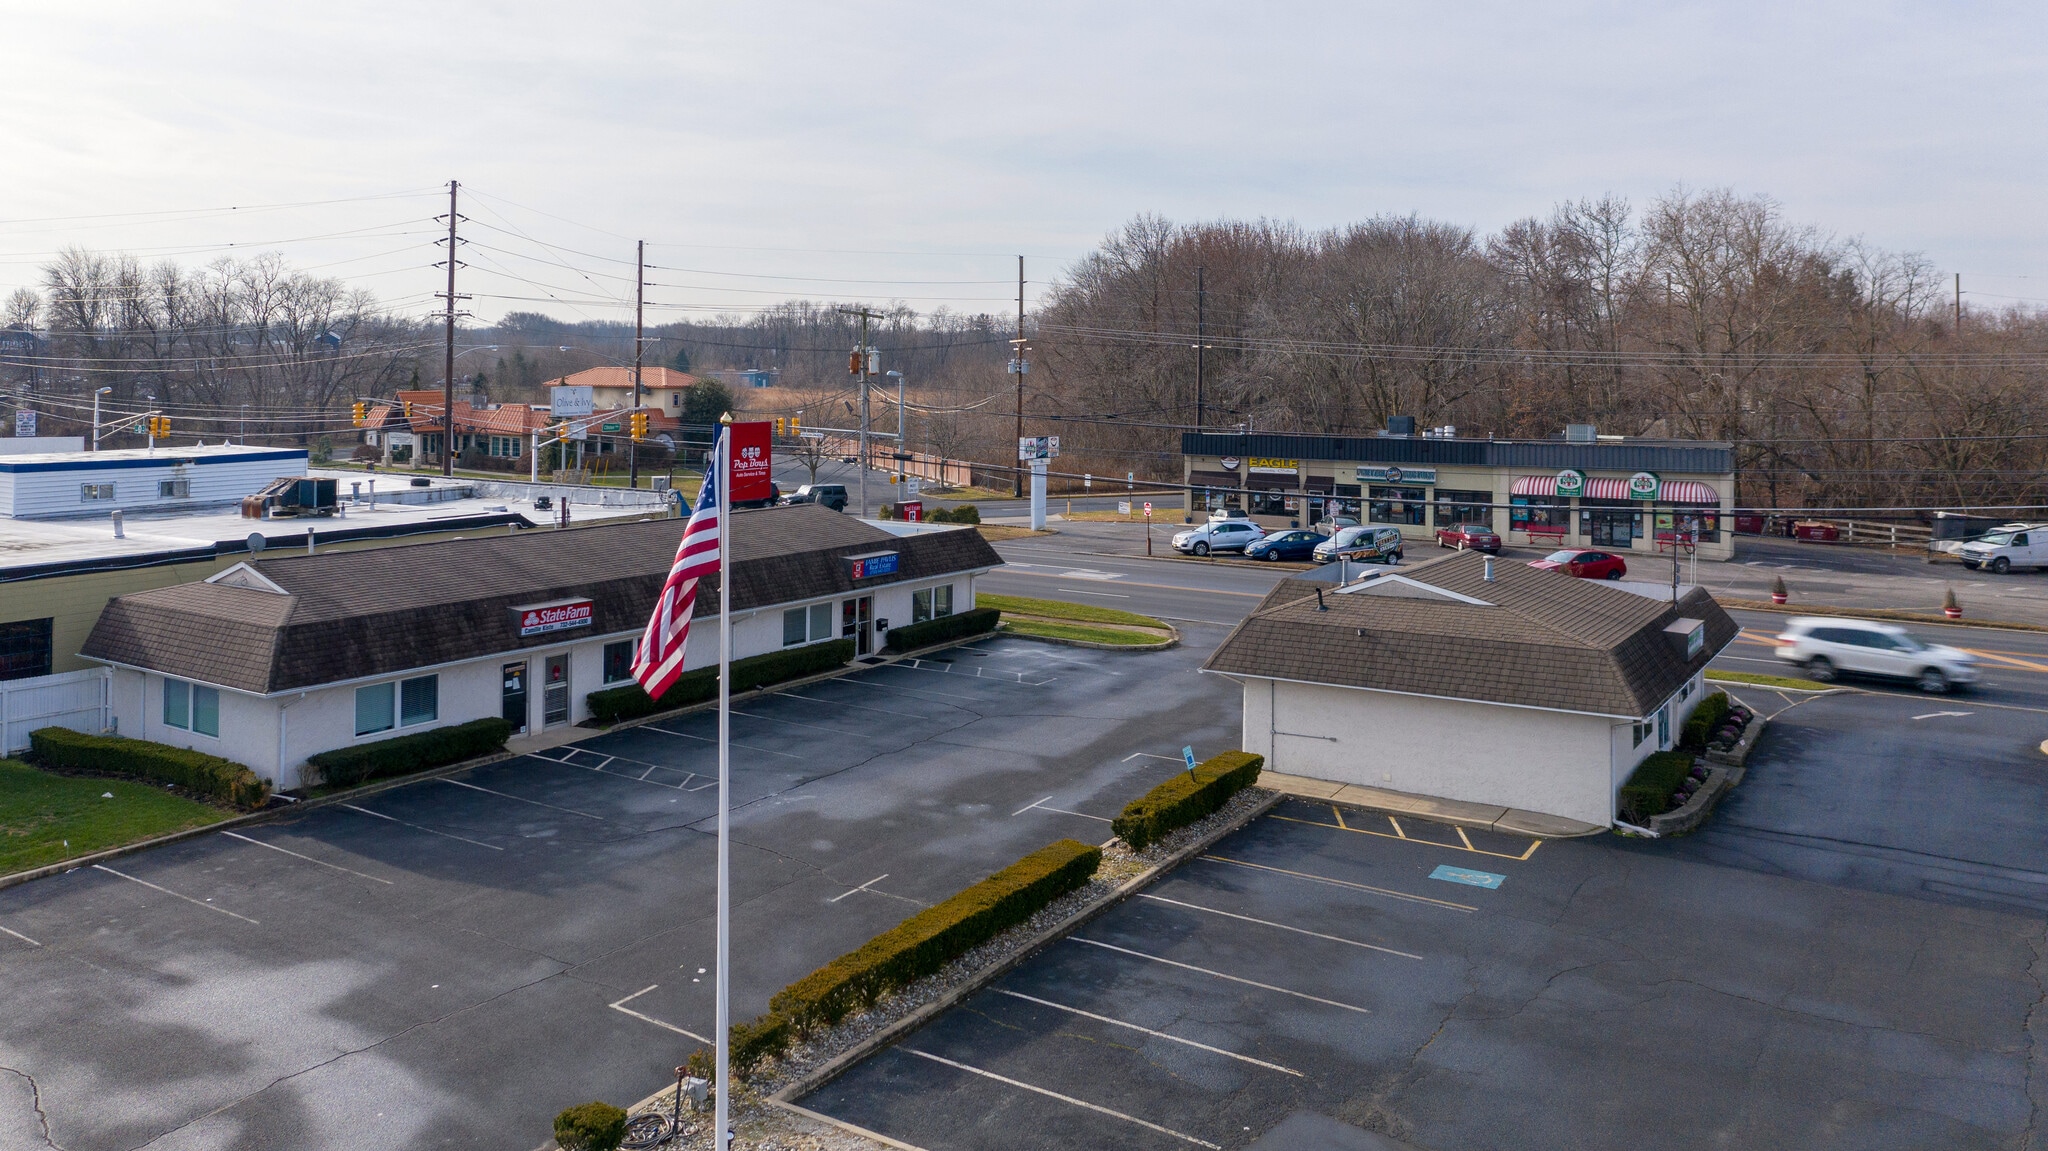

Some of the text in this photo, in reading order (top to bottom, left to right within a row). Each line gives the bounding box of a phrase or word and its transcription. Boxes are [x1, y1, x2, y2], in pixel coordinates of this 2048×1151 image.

[556, 397, 573, 408] Olive
[581, 397, 591, 409] Ivy
[734, 458, 769, 470] Pep Boys
[1248, 457, 1299, 469] EAGLE
